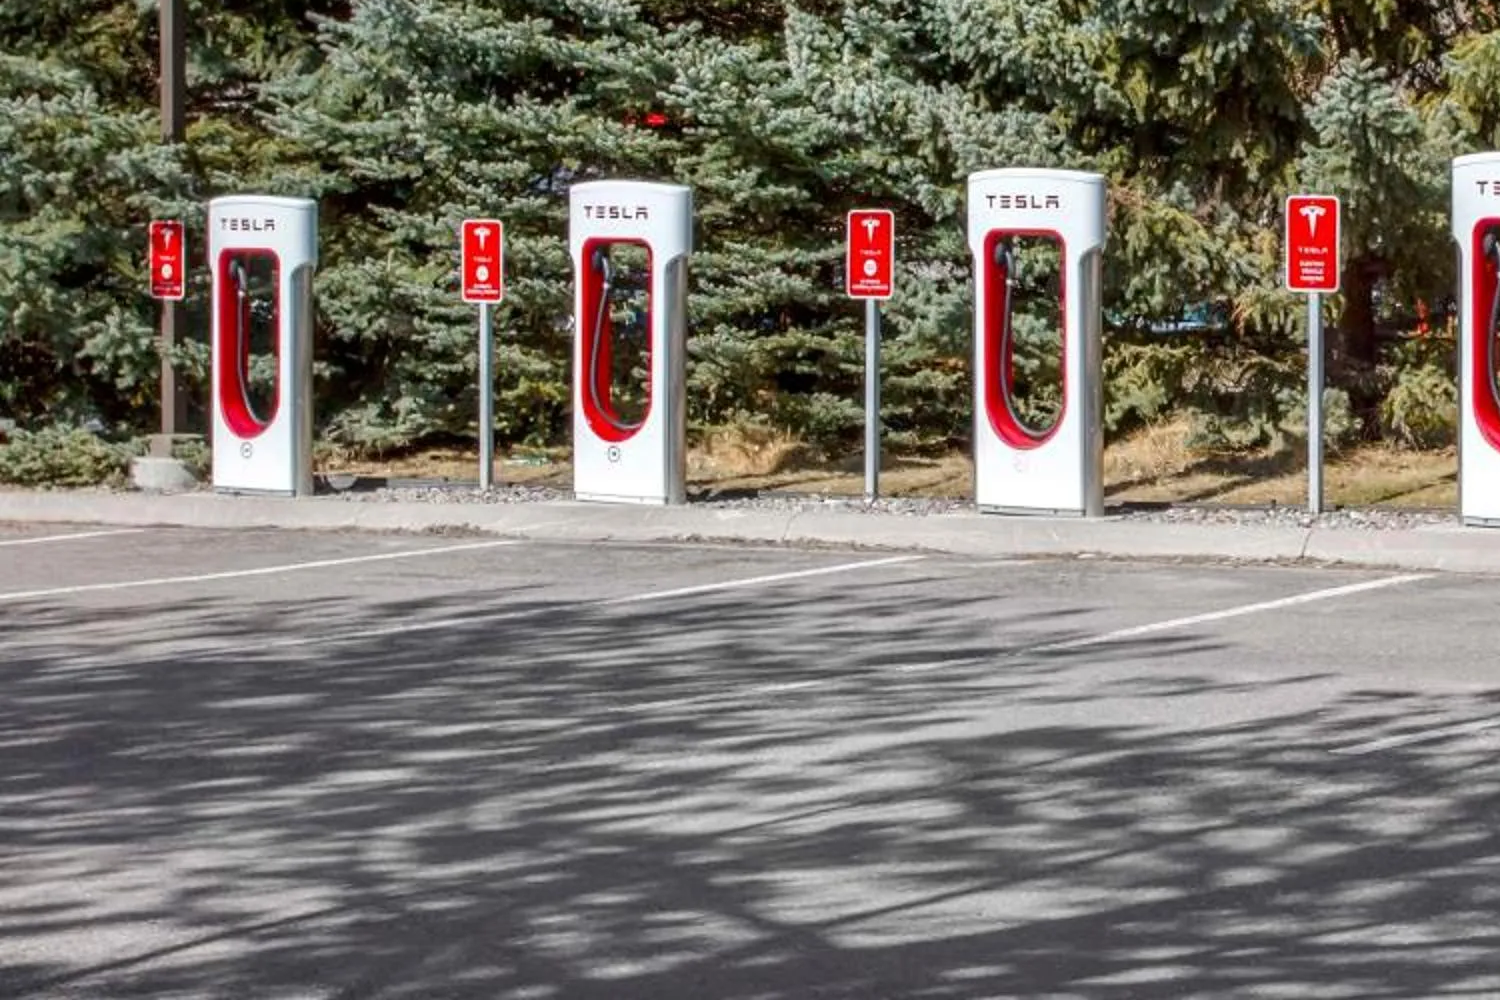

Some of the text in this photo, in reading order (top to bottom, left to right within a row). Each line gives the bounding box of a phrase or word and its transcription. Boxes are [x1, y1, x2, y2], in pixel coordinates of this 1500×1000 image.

[986, 195, 1060, 210] TESLA
[583, 205, 649, 220] TESLA
[220, 218, 275, 231] TESLA
[1298, 246, 1328, 255] TESLA
